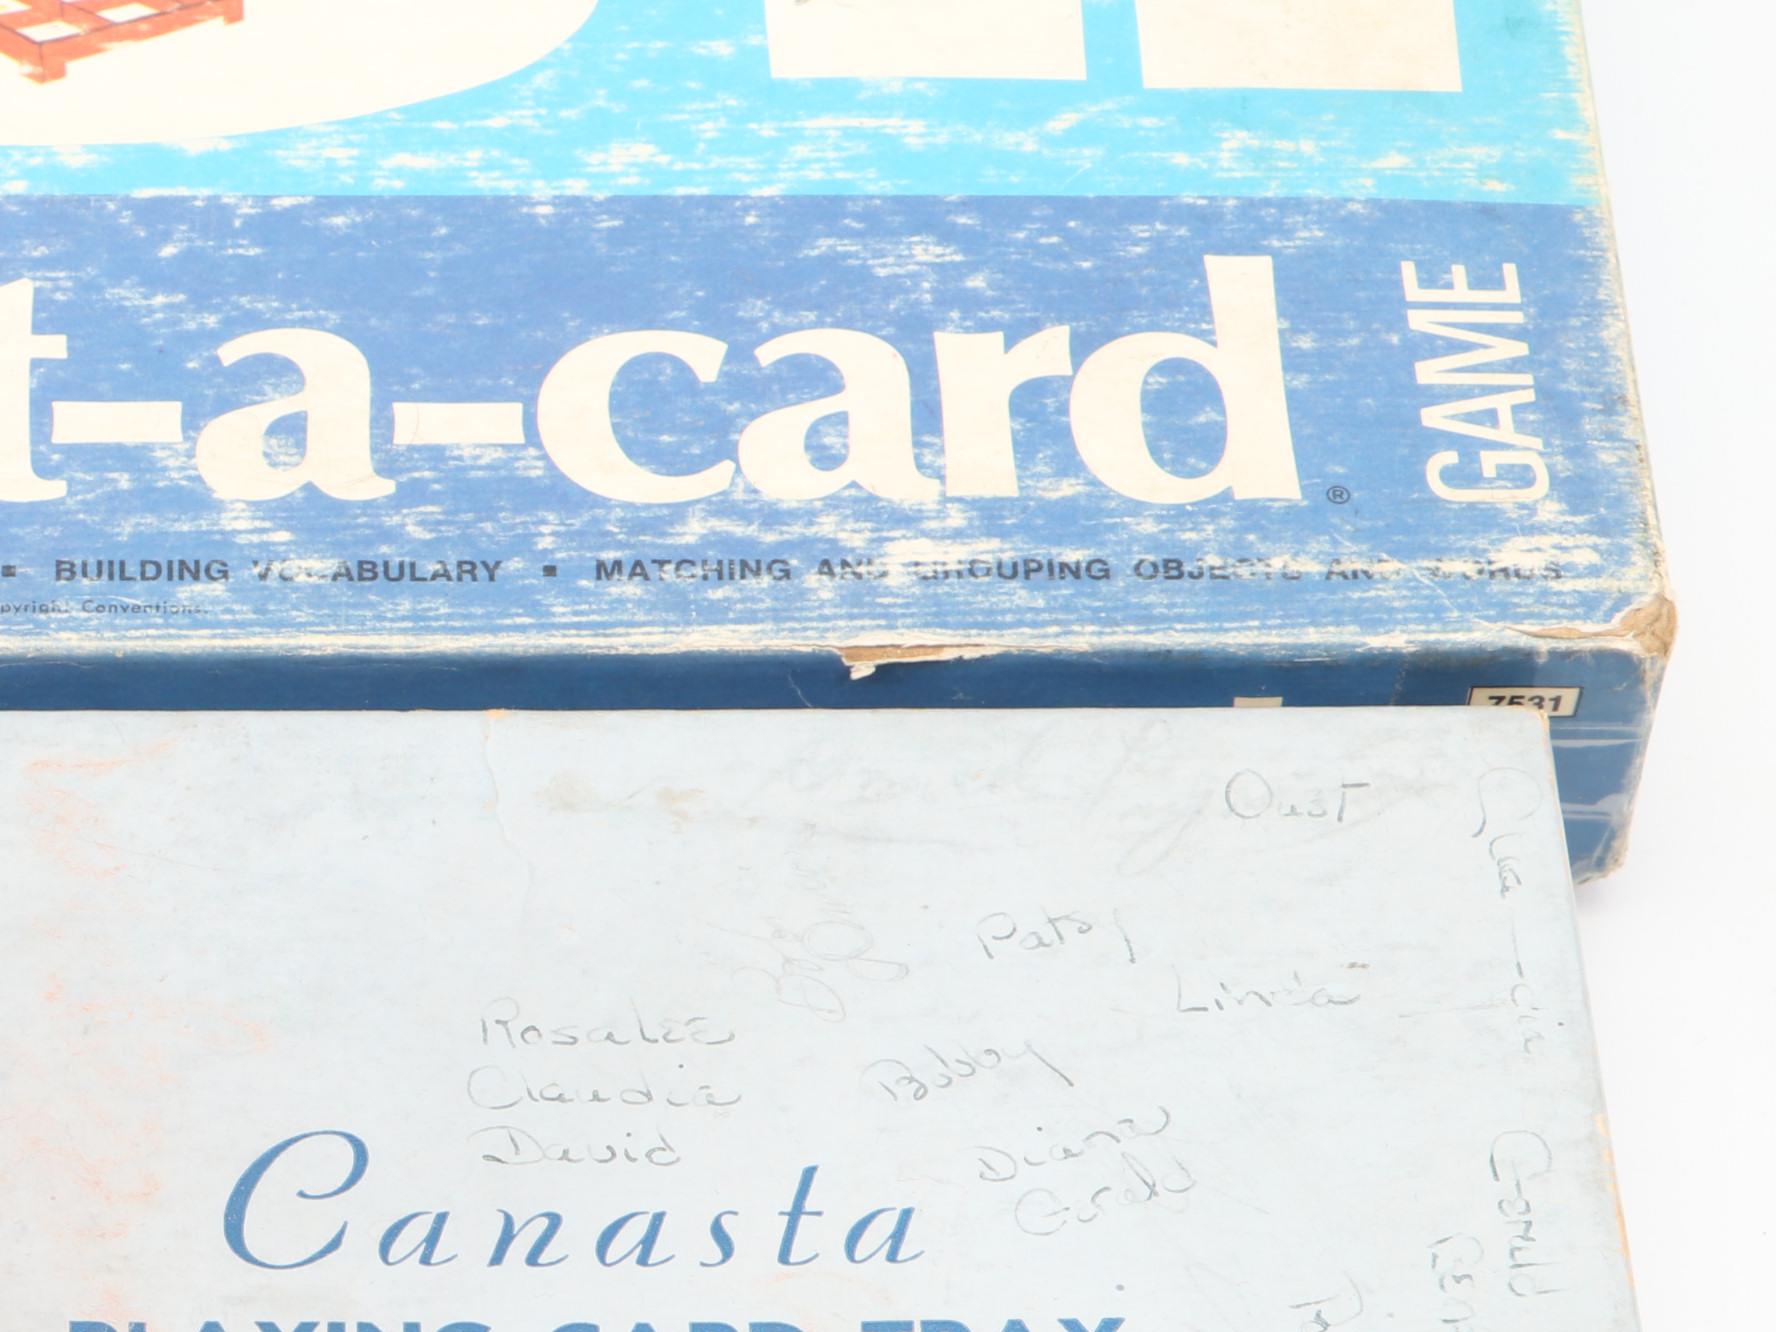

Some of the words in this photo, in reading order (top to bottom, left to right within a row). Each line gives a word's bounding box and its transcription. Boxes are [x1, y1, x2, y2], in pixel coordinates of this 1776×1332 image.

[1400, 258, 1550, 503] GAME
[55, 559, 229, 582] BUILDING
[251, 559, 505, 583] VOCABULARY
[595, 558, 792, 582] MATCHING
[817, 558, 888, 581] AND
[465, 1124, 682, 1167] David
[223, 1129, 927, 1271] Canasta
